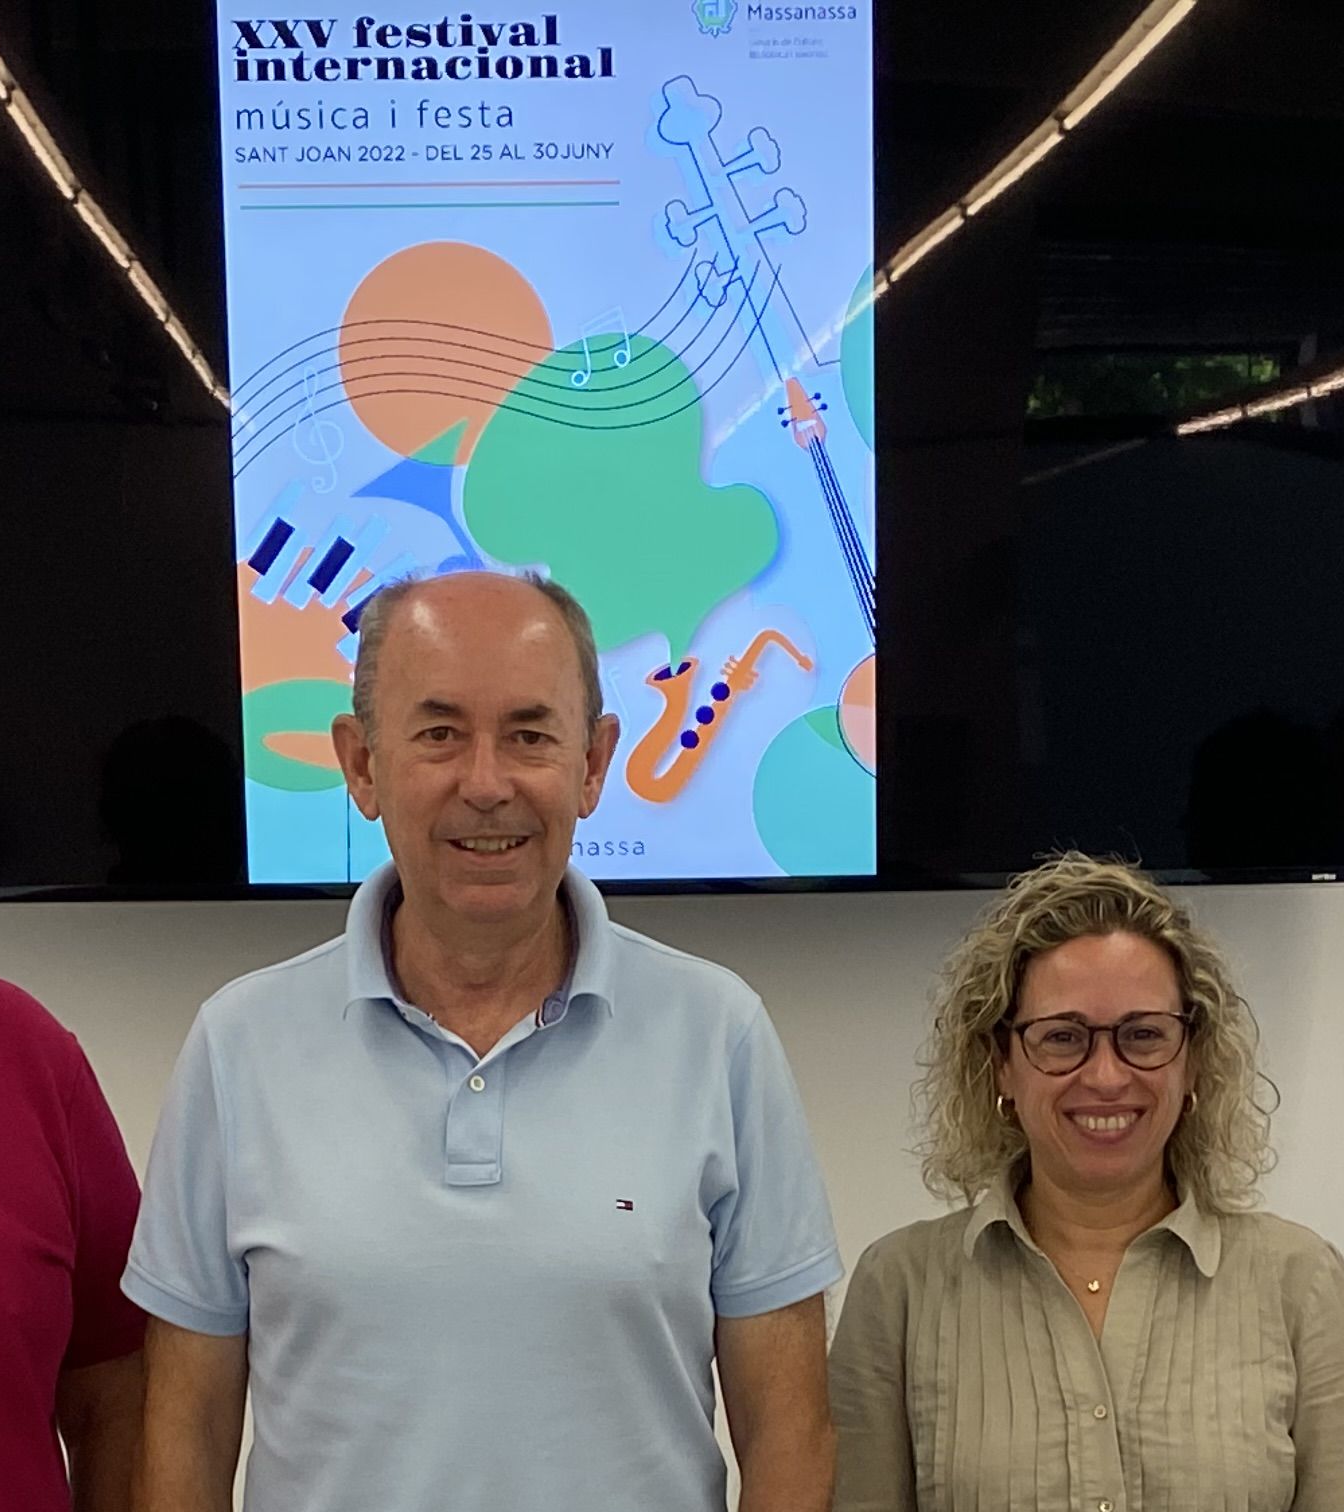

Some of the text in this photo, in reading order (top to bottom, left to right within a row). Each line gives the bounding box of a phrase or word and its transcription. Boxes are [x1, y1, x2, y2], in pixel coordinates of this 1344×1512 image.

[747, 4, 857, 21] Massanassa
[232, 13, 561, 48] XXV festival
[232, 46, 616, 82] internacional
[235, 98, 515, 131] música i festa
[234, 146, 288, 163] SANT
[295, 145, 352, 163] JOAN
[357, 145, 405, 162] 2022
[425, 144, 463, 161] DEL
[470, 144, 493, 161] 25
[499, 143, 525, 160] AL
[570, 840, 646, 857] nassa
